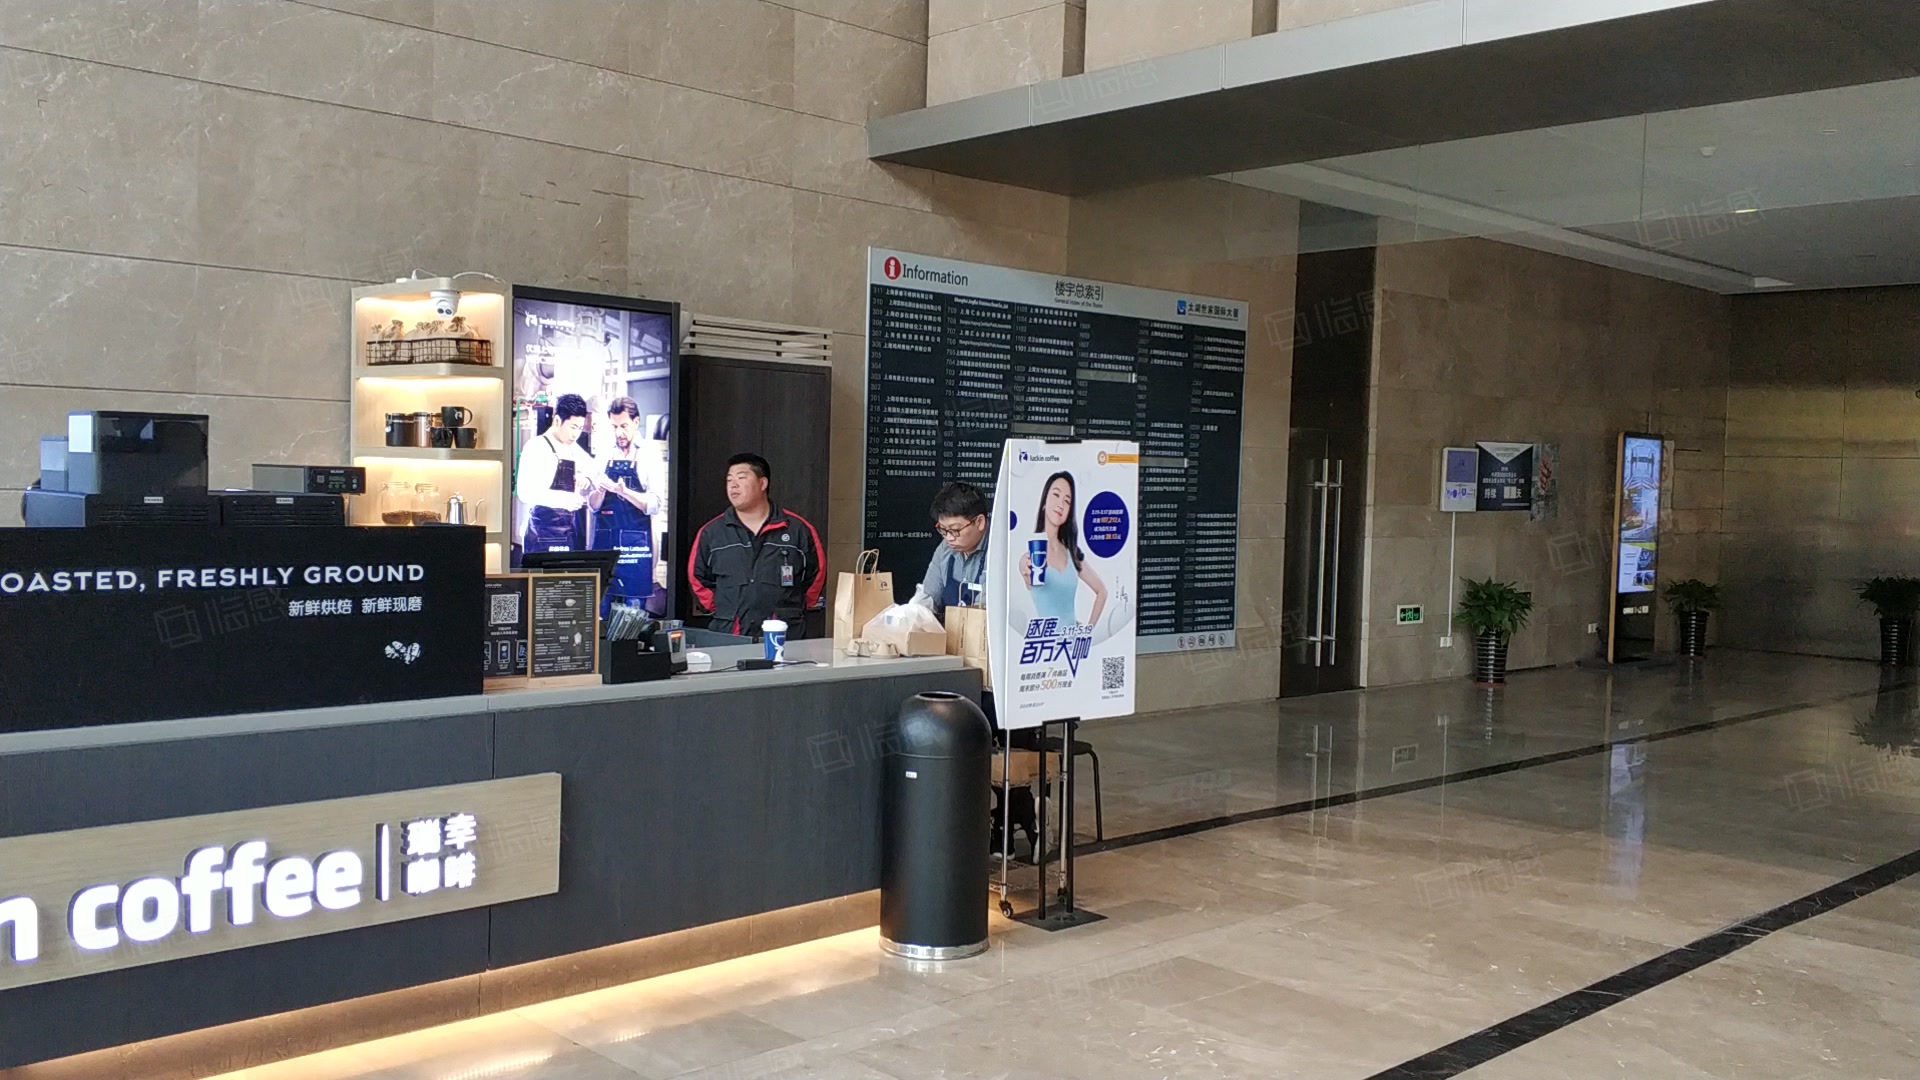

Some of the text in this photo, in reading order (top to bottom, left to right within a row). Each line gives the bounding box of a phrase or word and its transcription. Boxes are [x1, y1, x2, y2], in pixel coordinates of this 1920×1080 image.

[902, 263, 968, 286] Information
[1055, 280, 1104, 301] 楼宇总索引
[1030, 454, 1044, 462] luckin
[0, 564, 425, 594] OASTED, FRESHLY GROUND
[288, 596, 423, 617] 新鲜烘焙 新鲜现磨
[1024, 618, 1093, 639] 逐鹿 3.11-5.19
[1019, 636, 1092, 678] 百万大咖
[402, 813, 477, 855] 瑞幸
[402, 852, 477, 895] 咖啡
[70, 841, 363, 950] coffee
